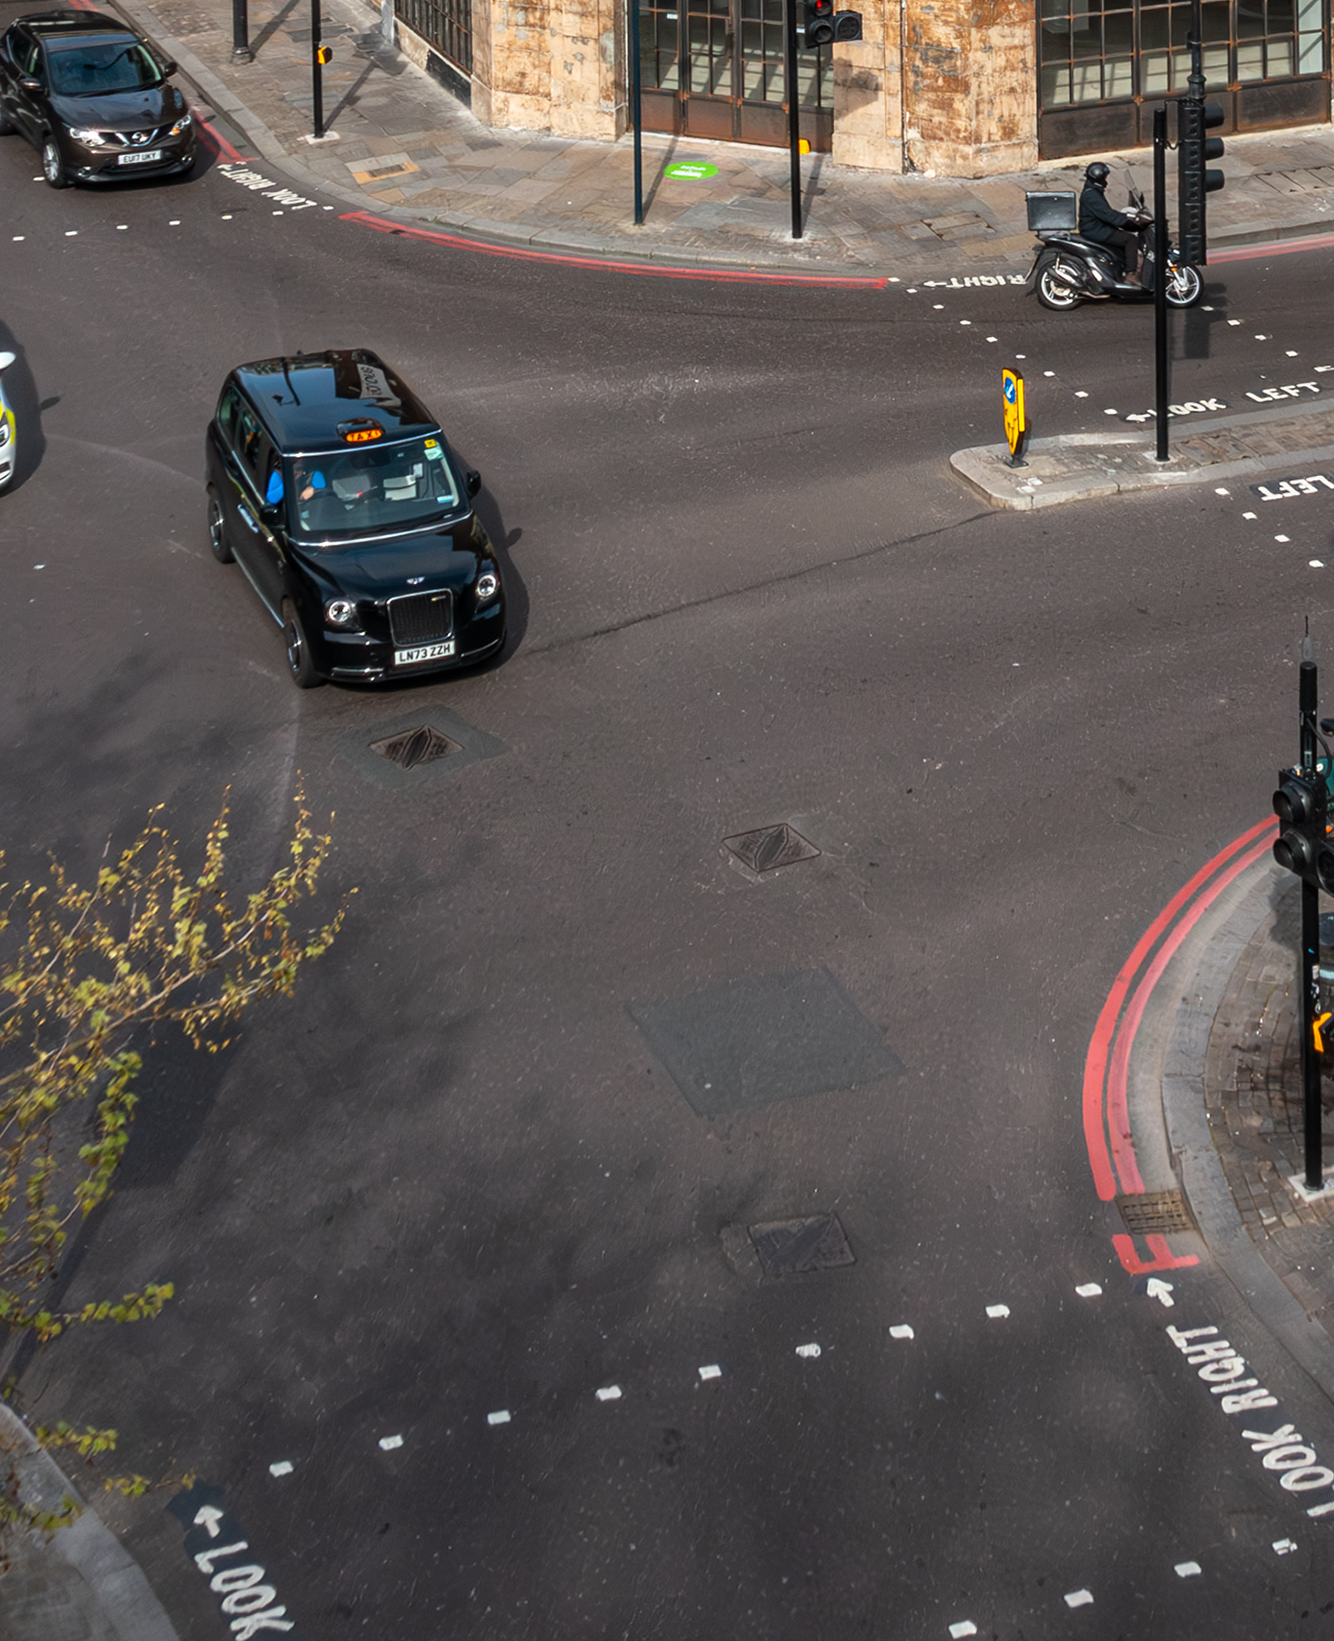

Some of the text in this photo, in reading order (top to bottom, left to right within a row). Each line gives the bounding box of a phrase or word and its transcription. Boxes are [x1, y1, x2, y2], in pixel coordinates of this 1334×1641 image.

[1245, 381, 1323, 404] LEFT
[349, 429, 382, 442] TAXI
[399, 643, 451, 663] LN73 ZZH
[1167, 1324, 1279, 1416] RIGHT
[194, 1539, 296, 1641] LOOK
